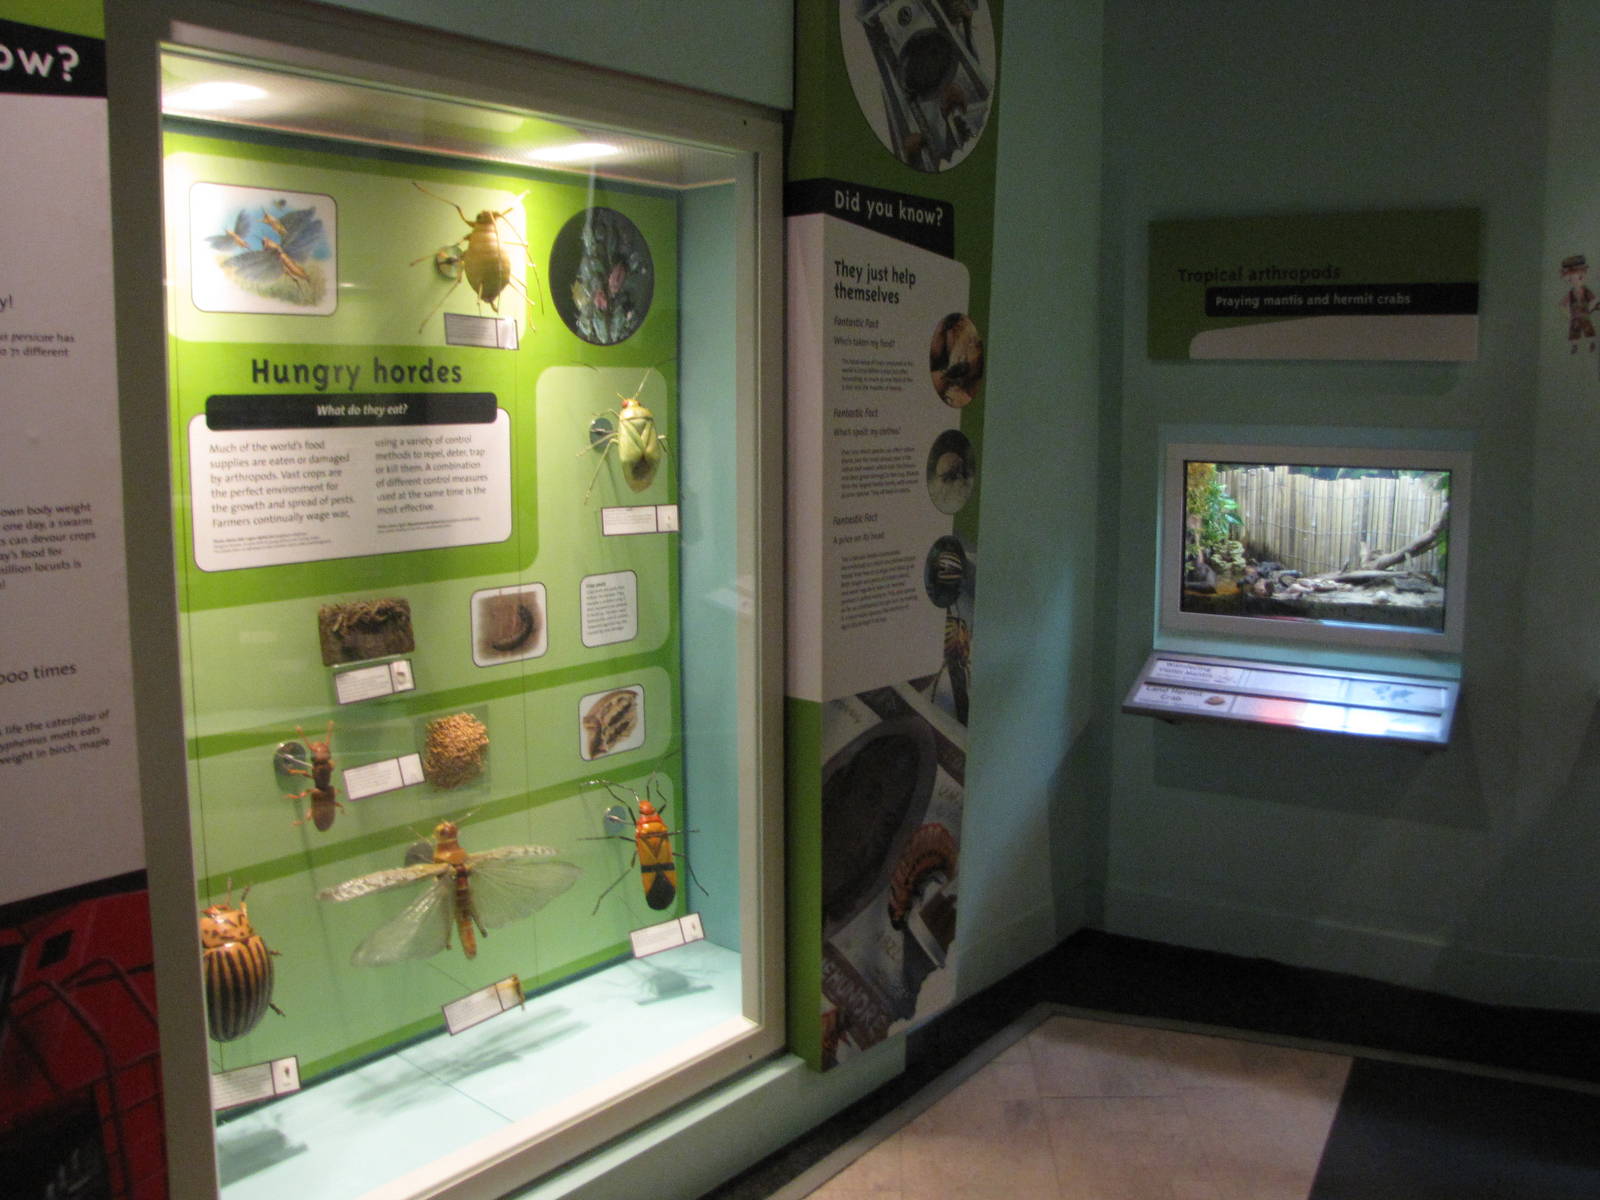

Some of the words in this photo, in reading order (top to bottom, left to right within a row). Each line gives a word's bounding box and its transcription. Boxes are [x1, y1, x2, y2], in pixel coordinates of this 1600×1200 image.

[834, 189, 861, 212] Did
[866, 200, 894, 221] you
[899, 199, 943, 227] know?
[834, 258, 864, 283] They
[866, 263, 889, 285] just
[891, 266, 917, 291] help
[1177, 265, 1244, 285] Tropical
[1248, 264, 1342, 284] arthropods
[834, 281, 900, 304] themselves
[1215, 296, 1260, 309] Praying
[1263, 294, 1304, 305] mantis
[1306, 293, 1329, 305] and
[1333, 292, 1374, 304] hermit
[1376, 292, 1411, 304] crabs
[56, 332, 75, 343] has
[23, 346, 69, 357] different
[251, 358, 361, 392] Hungry
[373, 356, 463, 384] hordes
[316, 404, 346, 417] What
[348, 405, 362, 416] do
[363, 404, 386, 418] they
[387, 403, 410, 415] eat?
[209, 443, 238, 454] Much
[240, 443, 250, 453] of
[252, 441, 269, 452] the
[270, 440, 303, 451] world's
[305, 439, 326, 450] food
[375, 440, 398, 450] using
[406, 436, 433, 448] variety
[434, 436, 445, 446] of
[445, 434, 472, 444] control
[210, 456, 249, 471] supplies
[252, 458, 266, 467] are
[268, 456, 295, 467] eaten
[297, 456, 307, 465] or
[308, 451, 351, 466] damaged
[376, 450, 411, 462] methods
[413, 449, 422, 460] to
[469, 447, 487, 458] trap
[376, 465, 385, 475] or
[425, 462, 432, 472] A
[433, 460, 481, 472] combination
[210, 474, 223, 487] by
[280, 468, 300, 480] Vast
[302, 470, 327, 481] crops
[328, 469, 343, 478] are
[376, 477, 385, 489] of
[386, 475, 422, 488] different
[423, 474, 451, 486] control
[452, 473, 488, 484] measures
[210, 488, 228, 499] the
[230, 486, 264, 501] perfect
[266, 482, 324, 496] environment
[326, 481, 339, 492] for
[408, 488, 422, 500] the
[466, 486, 472, 496] is
[473, 484, 487, 495] the
[26, 503, 53, 518] body
[55, 502, 92, 516] weight
[211, 502, 228, 514] the
[230, 500, 266, 515] growth
[268, 499, 285, 510] and
[287, 496, 318, 510] spread
[319, 496, 330, 506] of
[2, 522, 24, 532] one
[48, 520, 55, 529] a
[57, 518, 93, 529] swarm
[212, 517, 250, 530] Farmers
[252, 512, 304, 527] continually
[305, 512, 330, 524] wage
[8, 537, 28, 546] can
[30, 533, 66, 544] devour
[69, 531, 97, 543] crops
[20, 548, 46, 560] food
[47, 547, 63, 557] for
[34, 560, 71, 573] locusts
[72, 560, 82, 570] is
[33, 663, 78, 681] times
[25, 721, 43, 732] the
[45, 712, 97, 729] caterpillar
[98, 708, 111, 721] of
[50, 729, 78, 742] moth
[79, 725, 101, 737] eats
